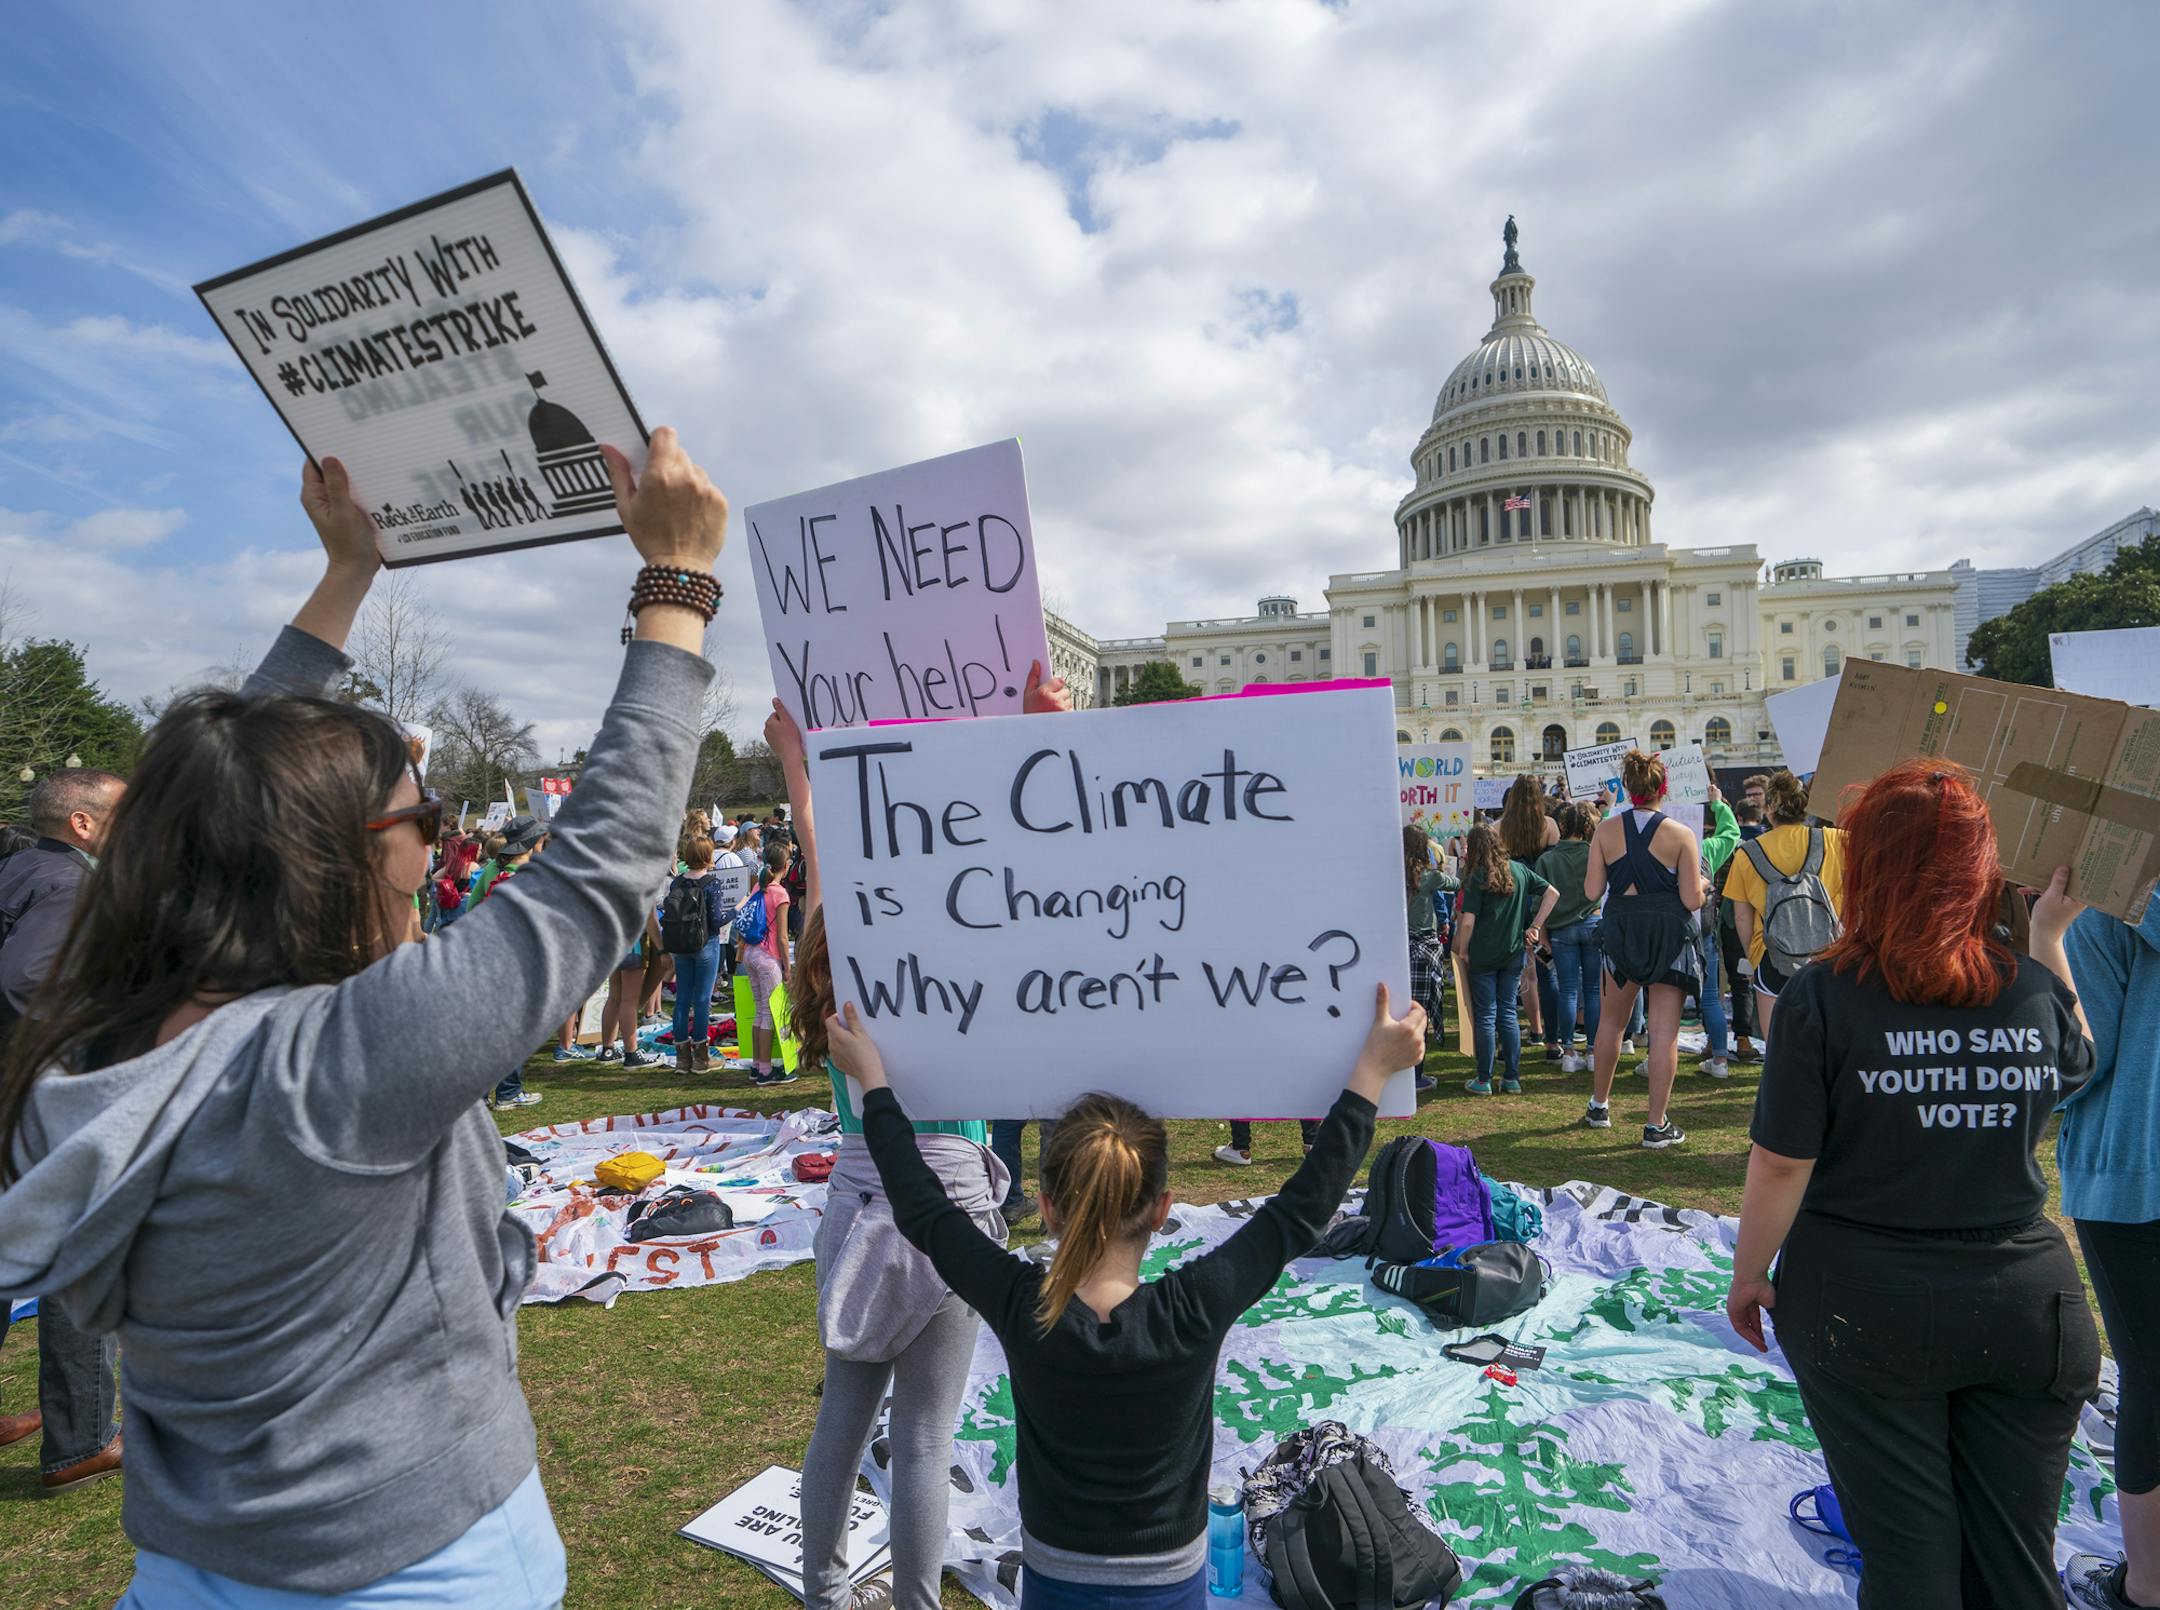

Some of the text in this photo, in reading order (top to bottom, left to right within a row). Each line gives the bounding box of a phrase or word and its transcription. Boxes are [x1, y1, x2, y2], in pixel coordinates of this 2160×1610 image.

[277, 291, 537, 397] #CLIMATESTRIKE
[412, 499, 460, 521] Earth
[752, 504, 1024, 615] WE NEED
[776, 614, 1018, 730] Your help!
[819, 741, 1295, 860] The Climate
[1400, 783, 1461, 806] ORTH IT
[853, 866, 1186, 940] is Changing
[846, 929, 1361, 1035] Why aren't we?
[1884, 1028, 2043, 1056] WHO SAYS
[1857, 1067, 1967, 1094] YOUTH
[1917, 1103, 2017, 1129] VOTE?
[734, 1515, 783, 1536] ARE
